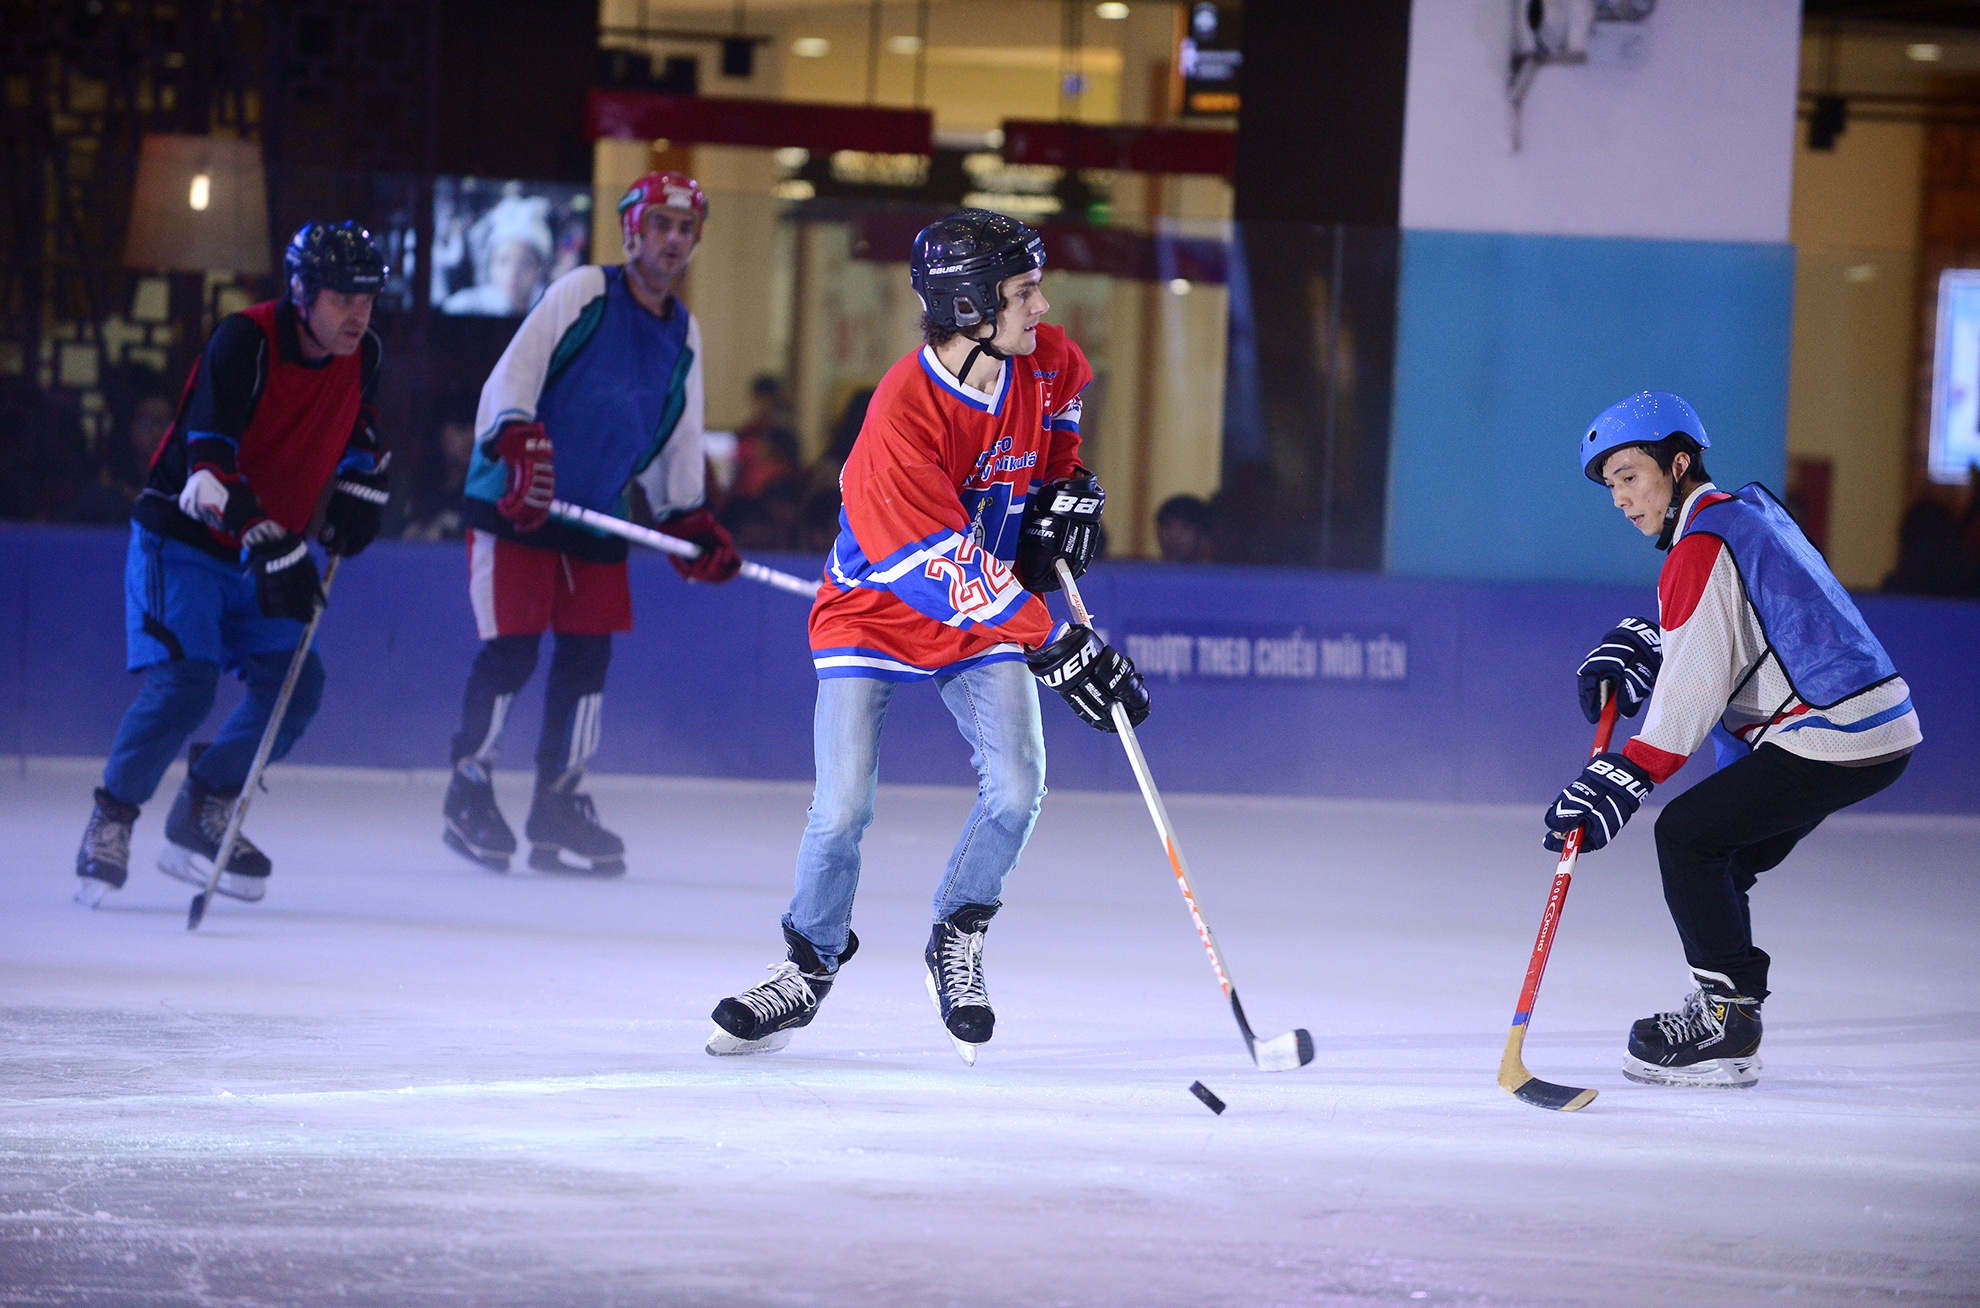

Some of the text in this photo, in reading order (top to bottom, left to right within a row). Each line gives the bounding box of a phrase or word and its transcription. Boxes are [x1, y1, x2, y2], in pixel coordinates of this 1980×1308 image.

[929, 264, 963, 276] BAUER
[924, 537, 1017, 616] 22
[1037, 640, 1098, 687] UER
